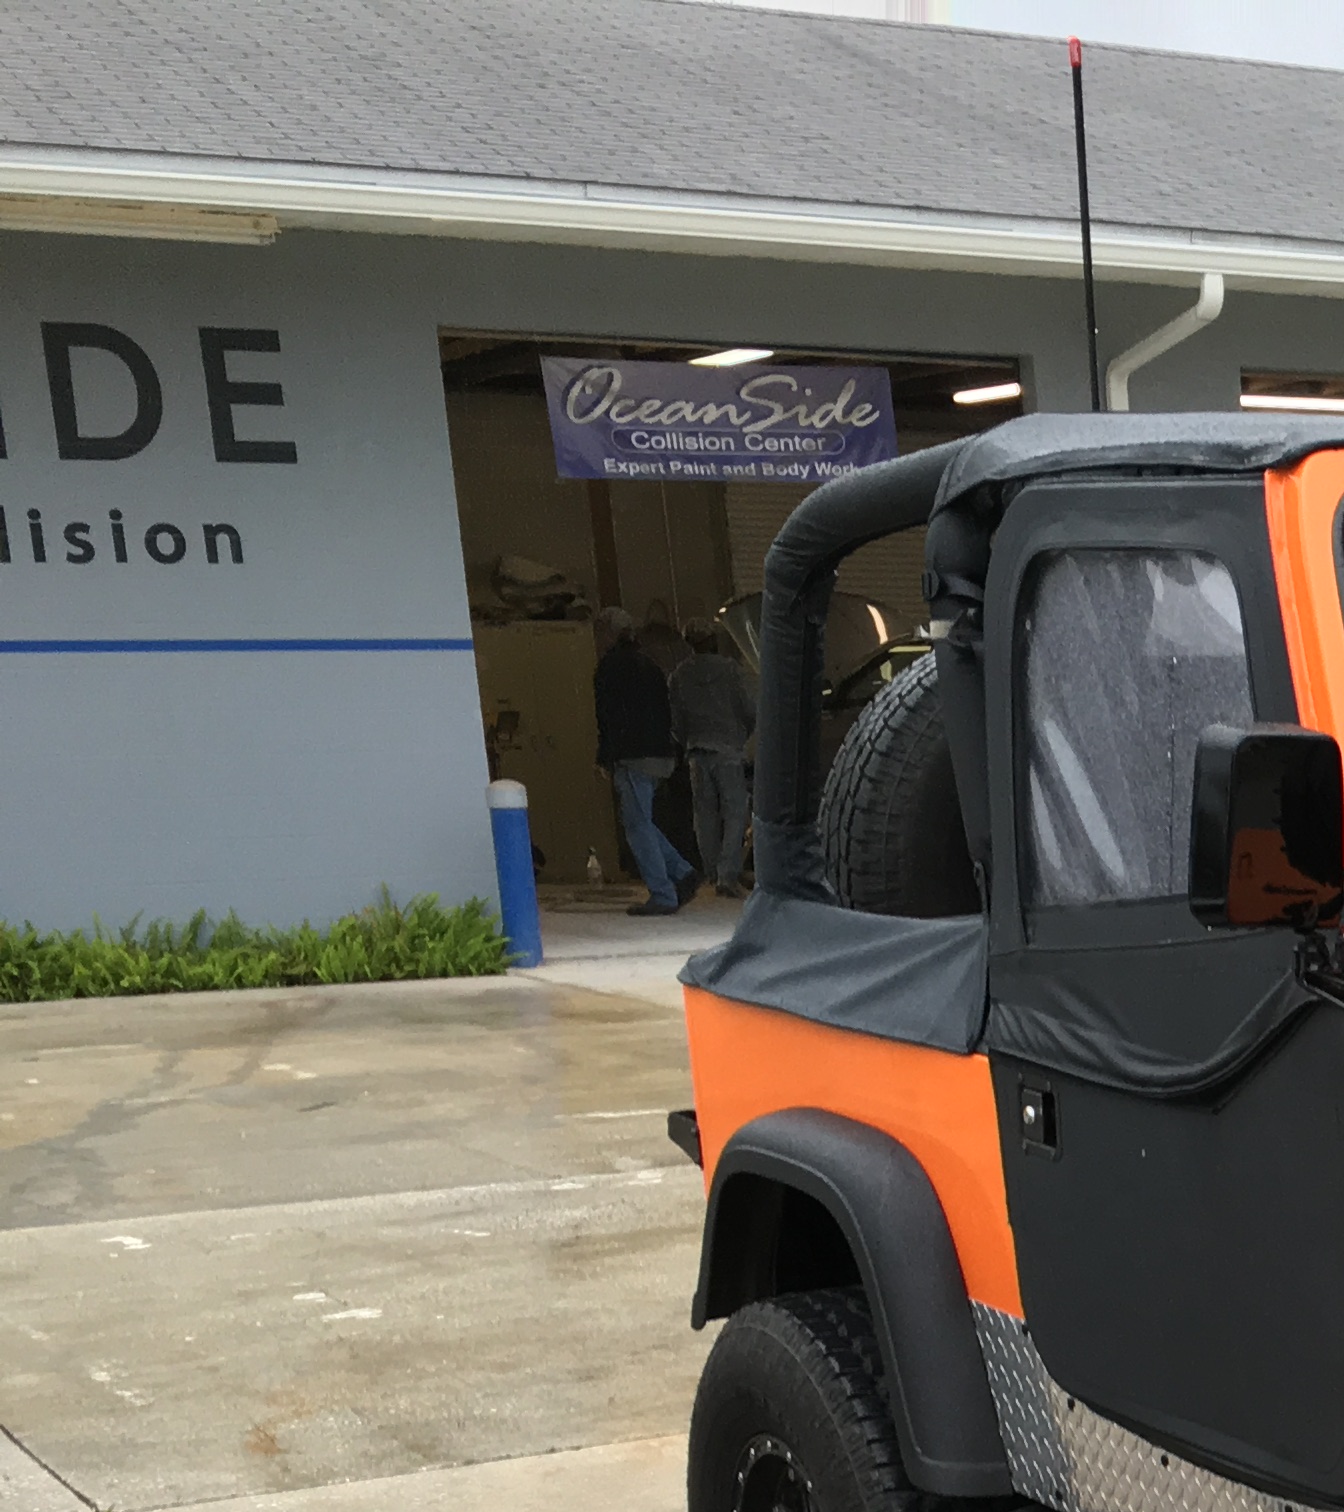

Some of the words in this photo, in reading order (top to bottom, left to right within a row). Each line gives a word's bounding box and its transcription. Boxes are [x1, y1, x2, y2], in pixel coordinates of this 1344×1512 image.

[0, 321, 297, 464] DE
[630, 431, 735, 452] Collision
[744, 433, 826, 452] Center
[603, 458, 664, 477] Expert
[669, 460, 717, 476] Paint
[722, 462, 755, 476] and
[762, 460, 809, 479] Body
